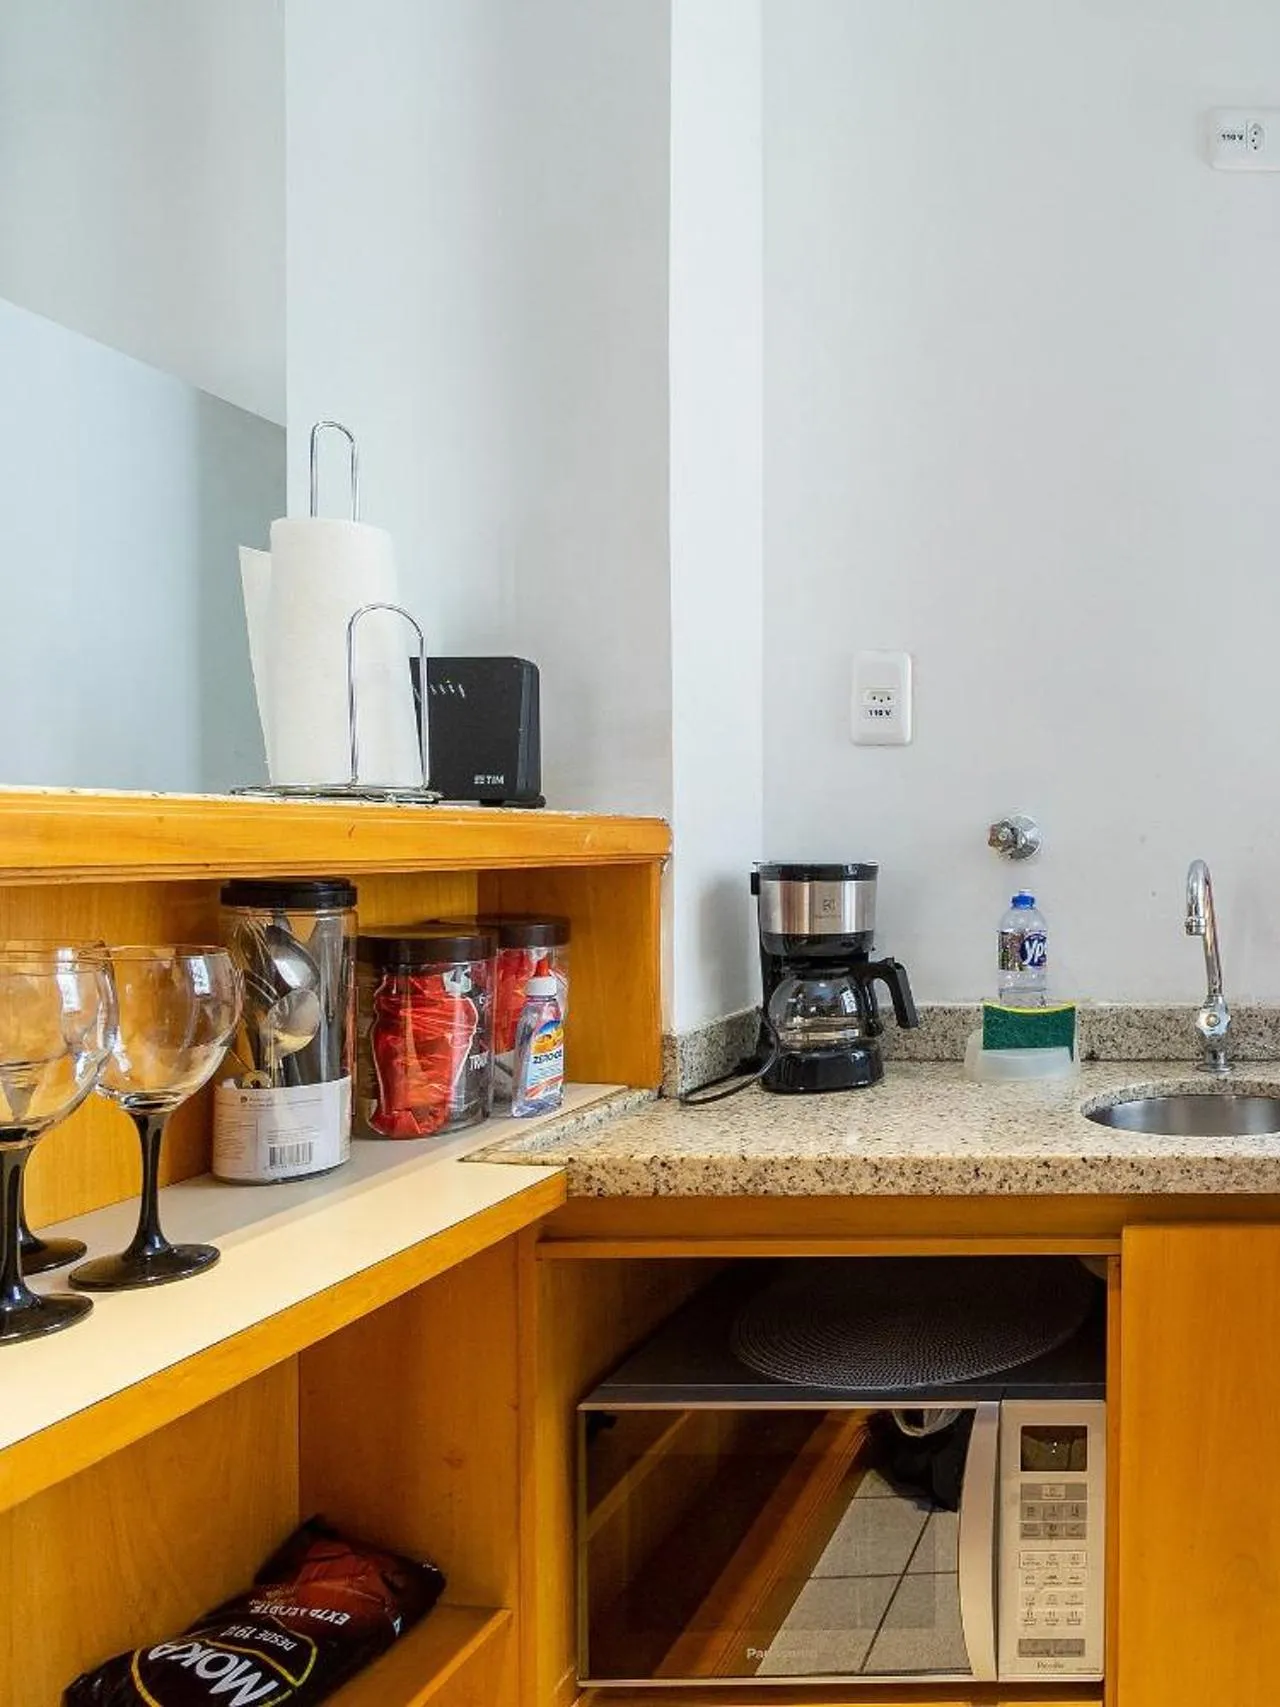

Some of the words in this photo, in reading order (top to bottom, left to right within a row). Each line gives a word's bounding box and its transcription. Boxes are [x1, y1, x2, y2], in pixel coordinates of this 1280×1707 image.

[486, 774, 505, 785] TIM
[254, 1629, 298, 1652] DESDE
[147, 1642, 279, 1707] MOKA
